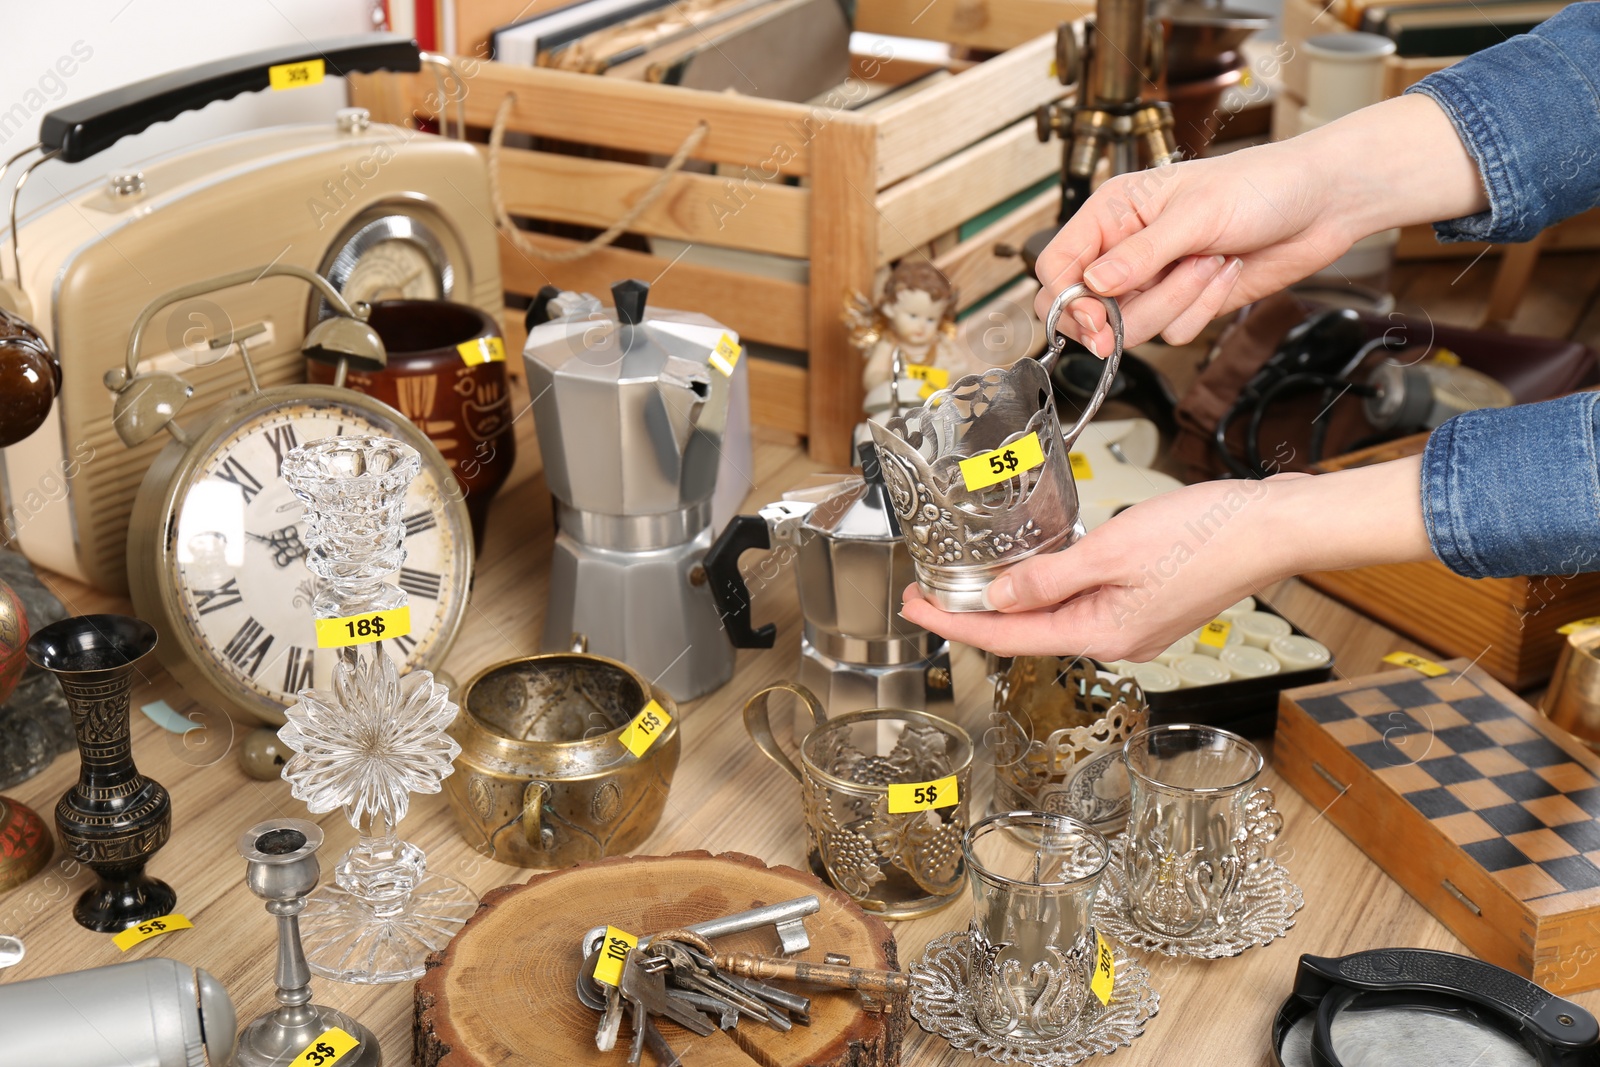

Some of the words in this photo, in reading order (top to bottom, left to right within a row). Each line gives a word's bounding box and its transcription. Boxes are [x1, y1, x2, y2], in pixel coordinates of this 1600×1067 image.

[989, 448, 1020, 475] 5$
[215, 456, 263, 504] XI
[345, 615, 386, 638] 18$
[637, 711, 662, 736] 15$
[914, 784, 939, 805] 5$
[138, 918, 168, 936] 5$
[607, 936, 632, 962] 10$
[1098, 943, 1112, 978] 30$
[305, 1041, 336, 1067] 3$
